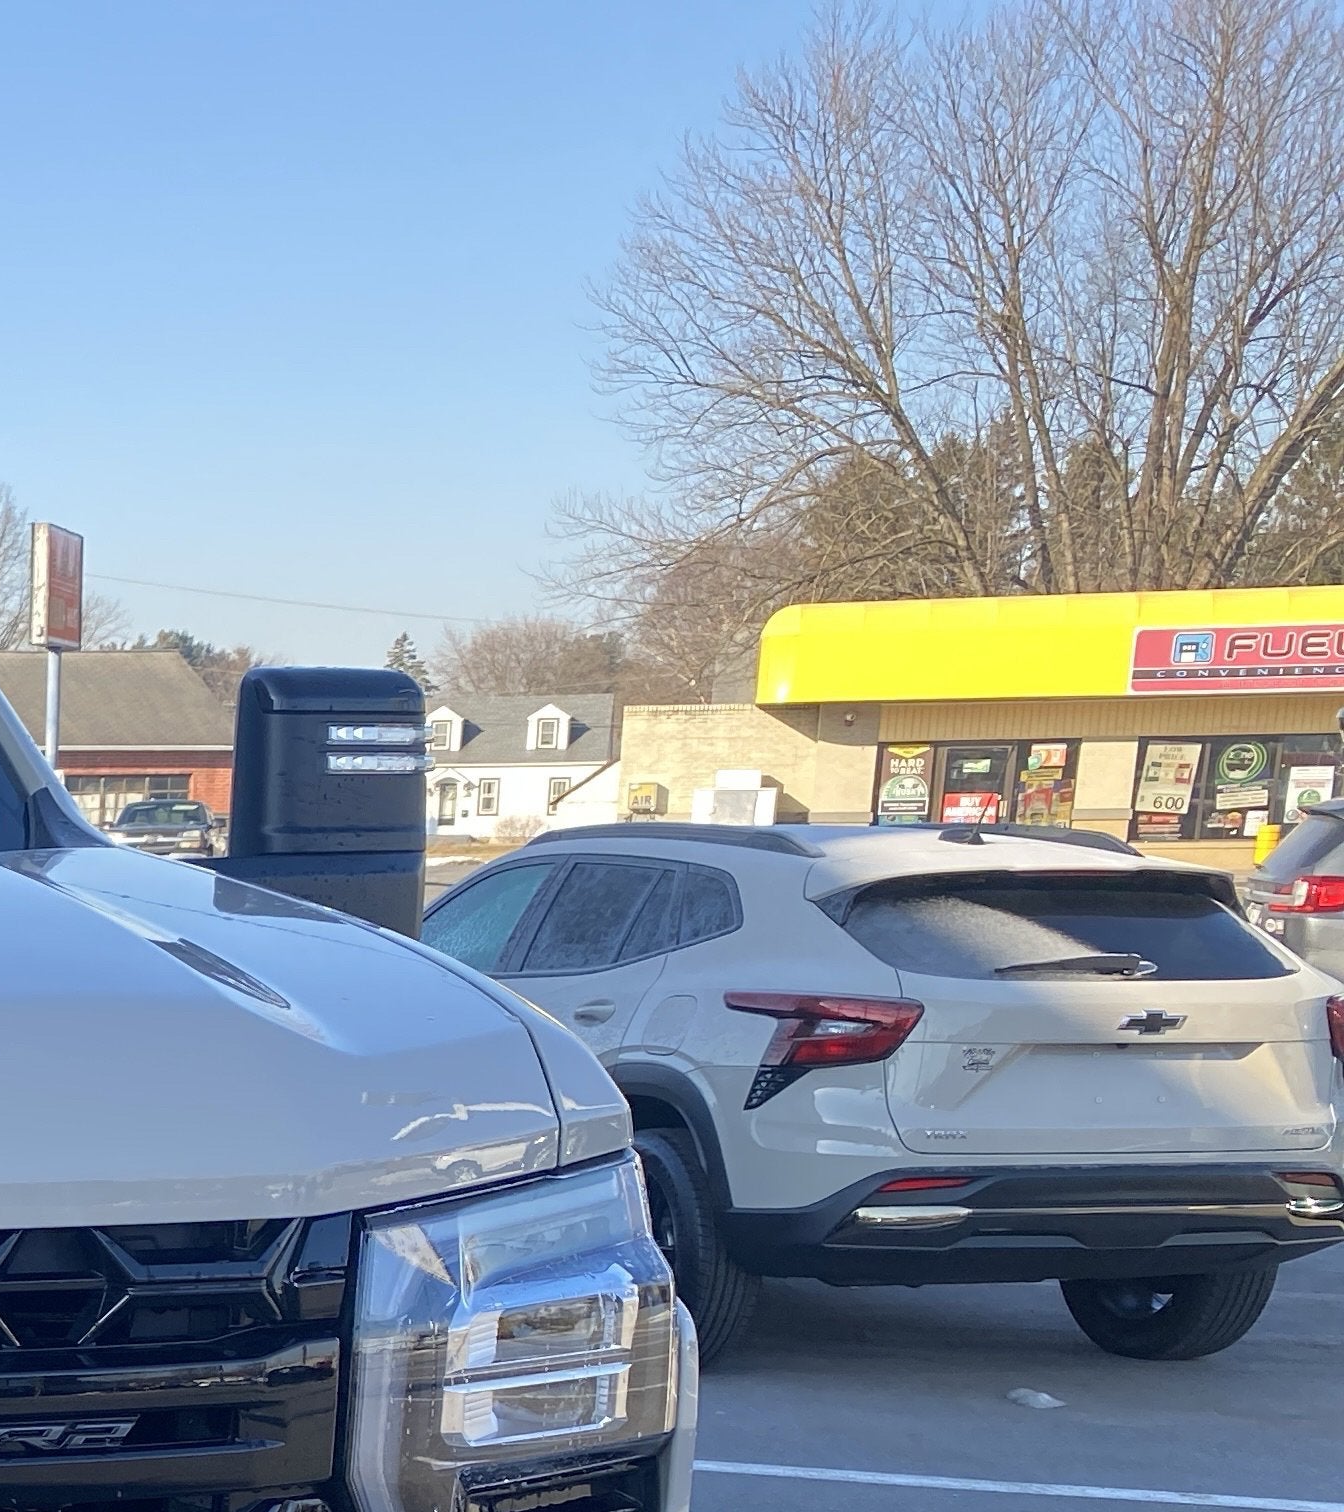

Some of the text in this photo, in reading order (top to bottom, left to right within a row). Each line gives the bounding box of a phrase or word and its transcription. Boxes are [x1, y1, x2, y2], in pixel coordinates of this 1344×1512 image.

[1224, 631, 1344, 661] FUE
[890, 758, 925, 768] HARD
[632, 795, 652, 806] AIR
[960, 796, 982, 807] BUY
